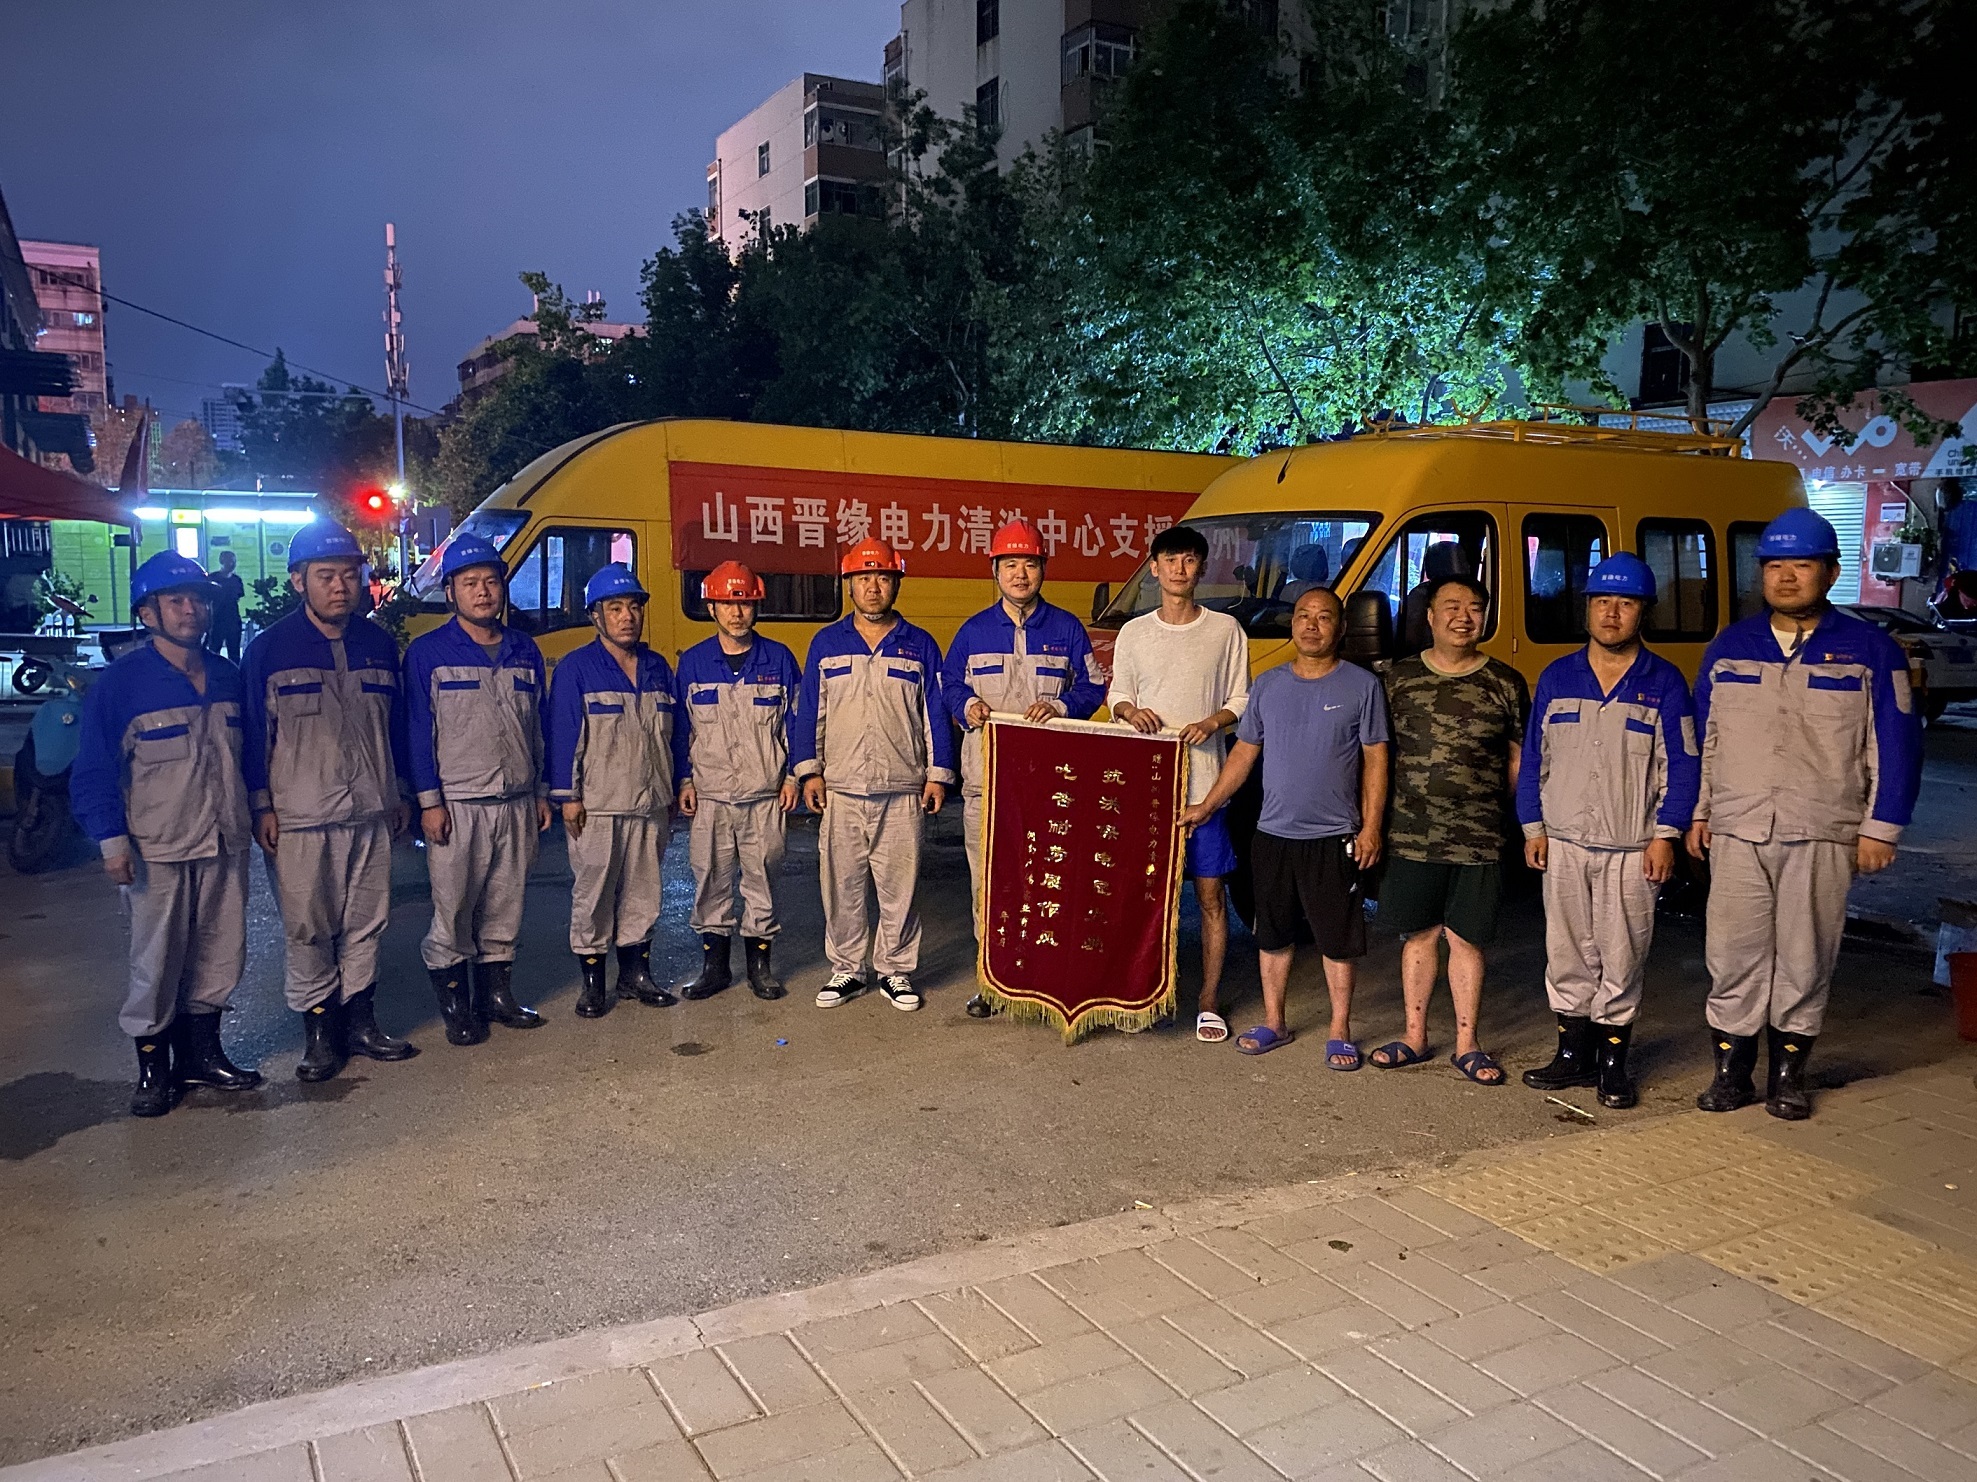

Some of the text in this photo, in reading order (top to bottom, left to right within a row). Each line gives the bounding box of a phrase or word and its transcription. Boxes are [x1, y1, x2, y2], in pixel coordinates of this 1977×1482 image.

[702, 491, 1240, 562] 山西晋缘电力清中心支援州
